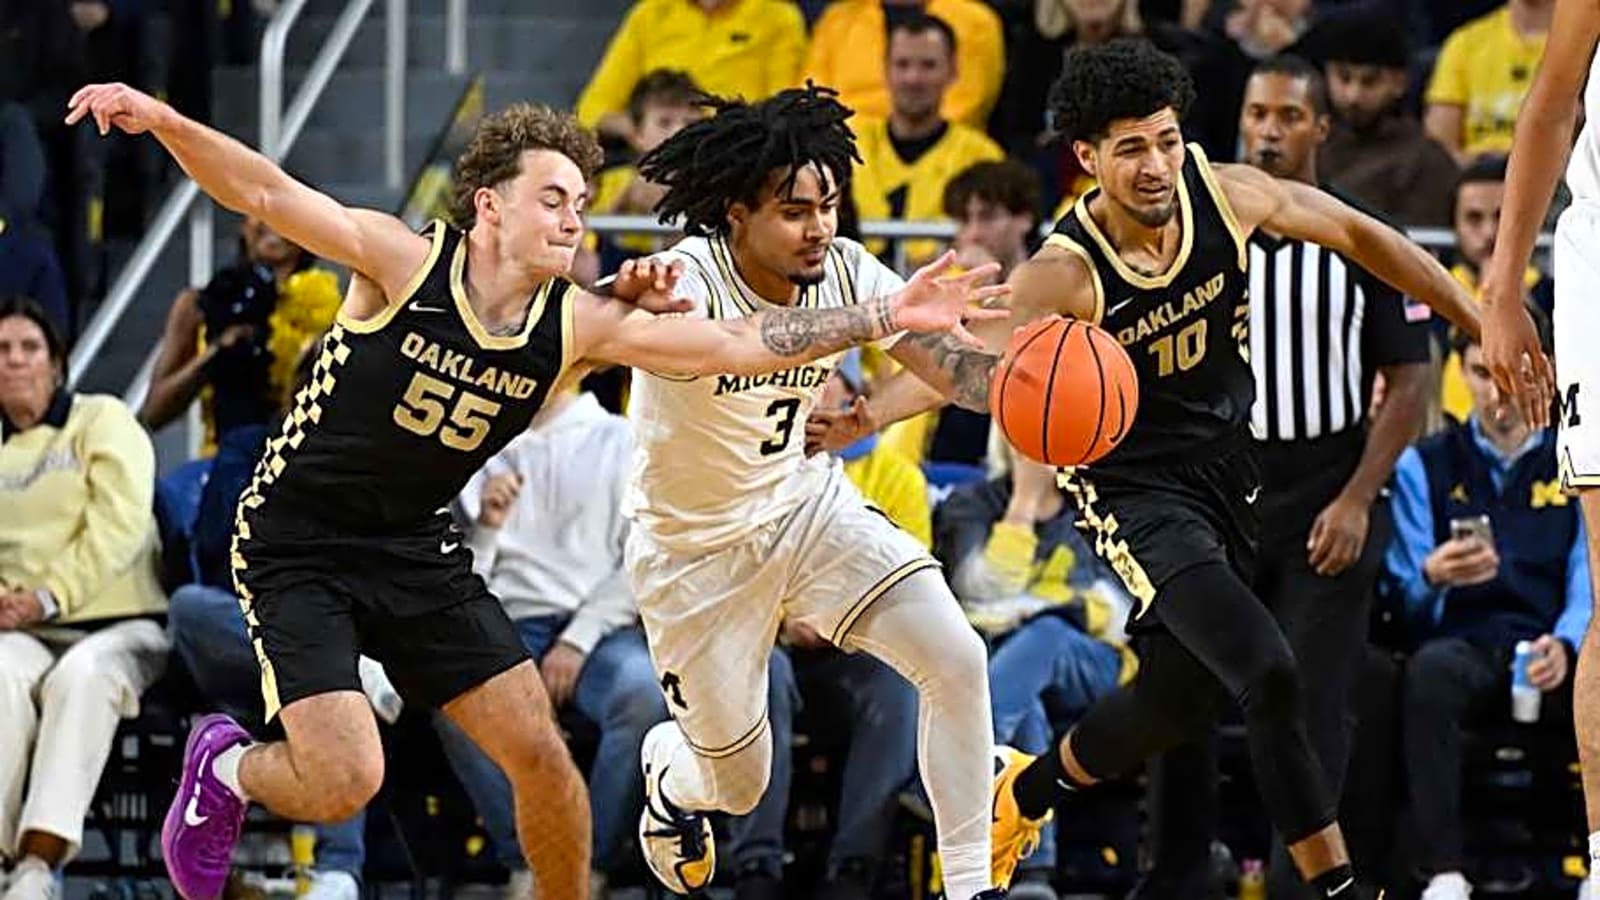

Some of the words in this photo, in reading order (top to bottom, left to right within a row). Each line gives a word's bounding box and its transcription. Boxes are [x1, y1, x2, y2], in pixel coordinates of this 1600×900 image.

[1117, 271, 1225, 346] OAKLAND
[400, 331, 538, 400] OAKLAND
[1148, 317, 1208, 377] 10
[393, 370, 502, 452] 55
[760, 398, 801, 456] 3
